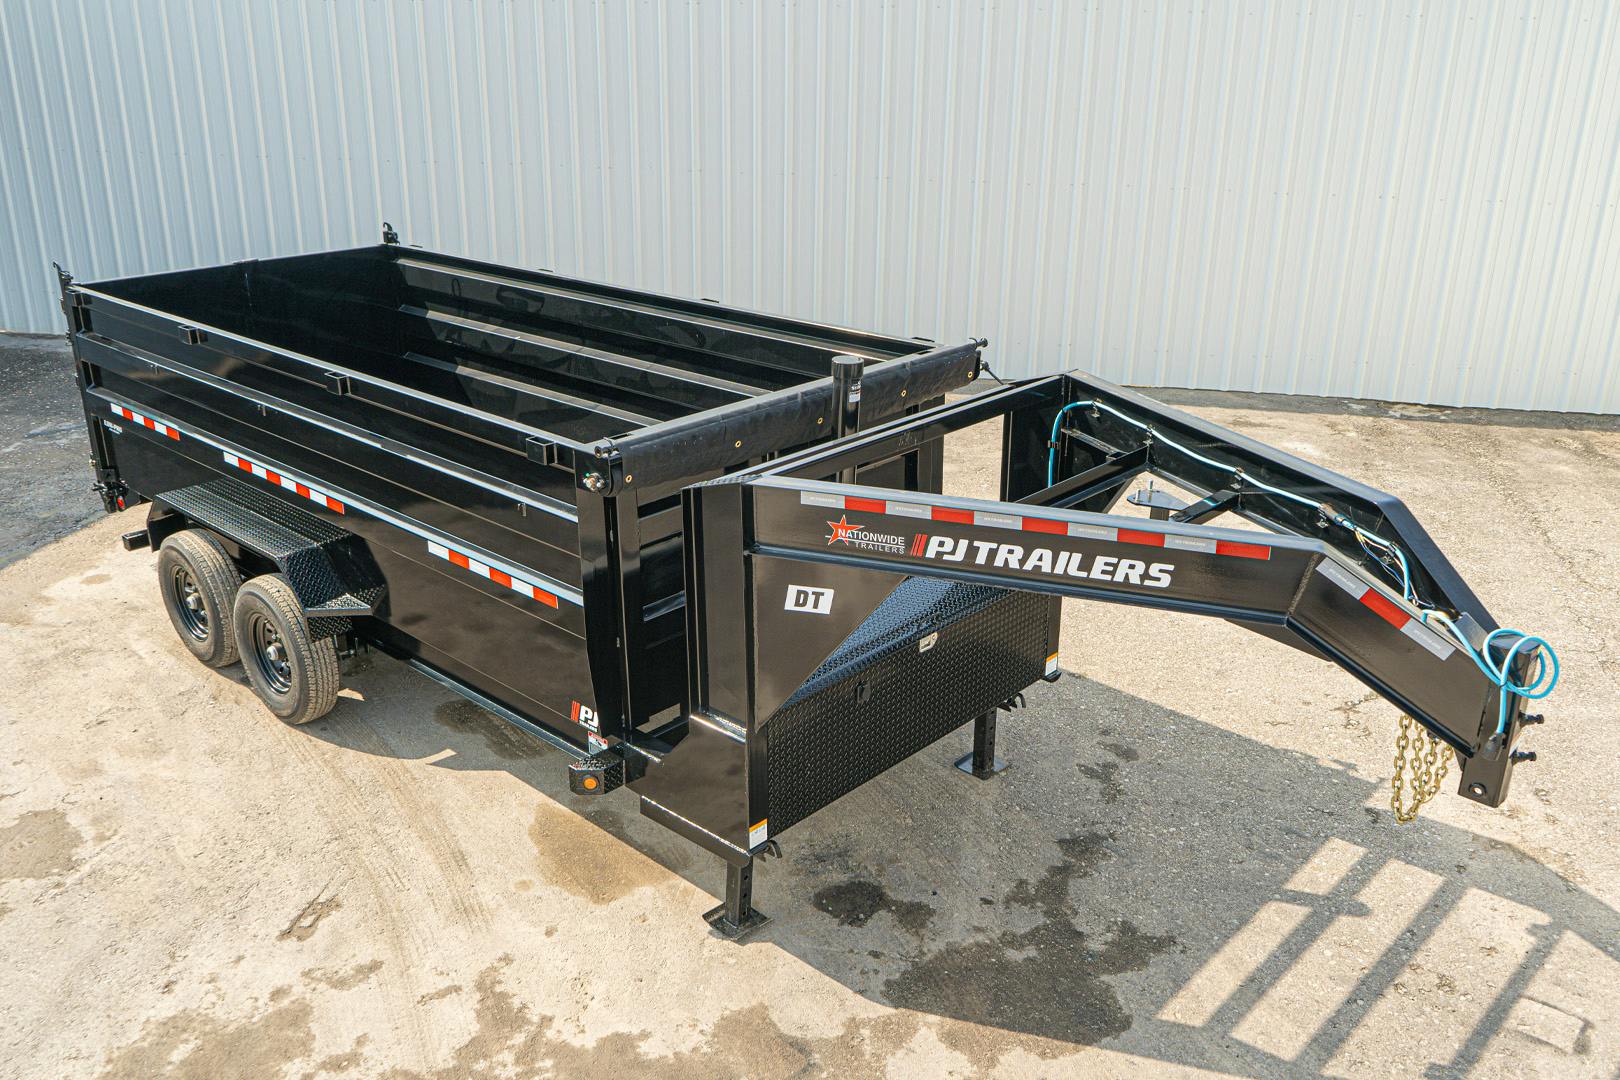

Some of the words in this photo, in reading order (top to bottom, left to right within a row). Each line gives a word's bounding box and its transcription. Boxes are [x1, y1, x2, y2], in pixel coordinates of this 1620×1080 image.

[837, 528, 906, 546] NATIONWIDE
[855, 541, 906, 555] TRAILERS
[925, 535, 969, 562] PJ
[972, 540, 1176, 588] TRAILERS
[793, 589, 825, 610] DT
[579, 705, 599, 728] PJ
